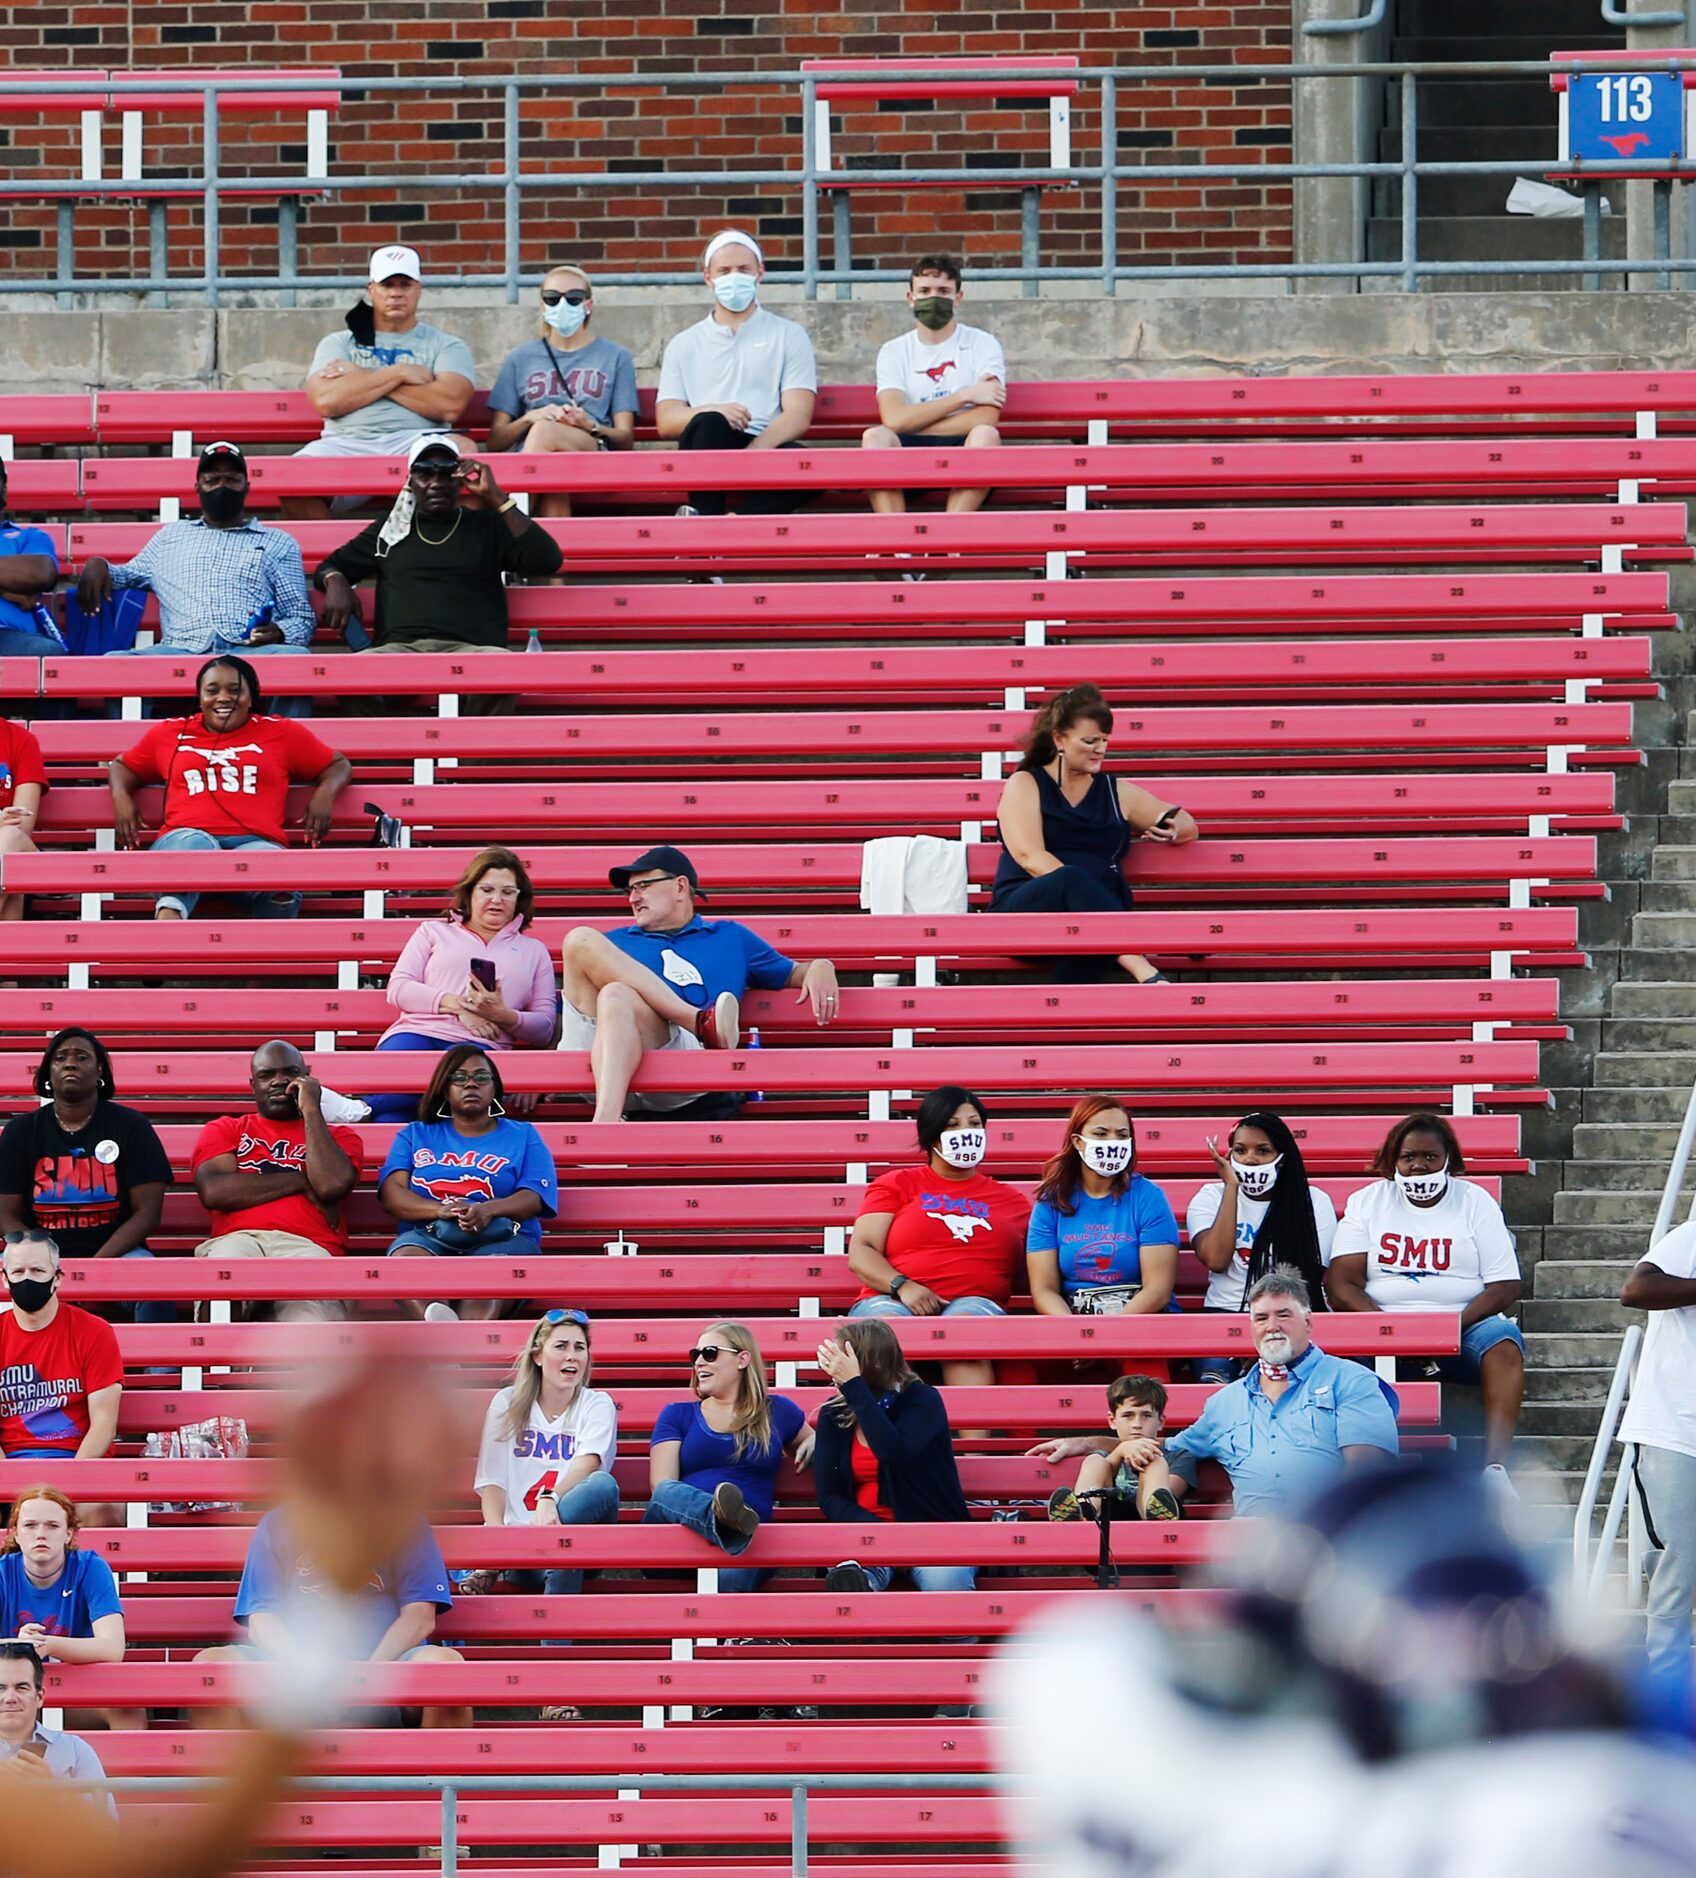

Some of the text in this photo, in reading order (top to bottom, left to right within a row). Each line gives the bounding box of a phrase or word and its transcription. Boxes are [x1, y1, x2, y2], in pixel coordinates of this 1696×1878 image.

[1596, 76, 1652, 122] 113
[526, 368, 608, 402] SMU
[892, 594, 905, 603] 18
[451, 665, 464, 675] 15
[183, 765, 259, 797] RISE
[1537, 786, 1551, 796] 22
[967, 792, 980, 802] 18
[1374, 851, 1387, 861] 21
[1519, 850, 1533, 860] 22
[93, 864, 106, 873] 12
[377, 861, 389, 871] 14
[1209, 924, 1224, 934] 20
[1046, 997, 1059, 1007] 19
[1191, 996, 1206, 1006] 20
[1335, 994, 1347, 1003] 21
[1478, 992, 1493, 1002] 22
[903, 999, 915, 1009] 18
[1023, 1059, 1037, 1068] 19
[1459, 1054, 1474, 1064] 22
[732, 1061, 745, 1071] 17
[877, 1060, 890, 1070] 18
[565, 1135, 577, 1145] 15
[710, 1134, 723, 1144] 16
[855, 1133, 869, 1143] 17
[949, 1132, 984, 1151] SMU
[955, 1152, 977, 1162] #96
[1094, 1146, 1128, 1160] SMU
[413, 1147, 510, 1175] SMU
[34, 1155, 118, 1199] SMU
[1403, 1181, 1440, 1194] SMU
[686, 1199, 699, 1208] 16
[832, 1197, 846, 1206] 17
[920, 1191, 992, 1219] SMU
[1378, 1232, 1453, 1271] SMU
[72, 1271, 85, 1281] 12
[218, 1270, 231, 1280] 13
[366, 1270, 379, 1279] 14
[513, 1269, 526, 1279] 15
[660, 1268, 673, 1278] 16
[807, 1267, 822, 1277] 17
[932, 1330, 945, 1339] 18
[1081, 1328, 1095, 1338] 19
[1379, 1325, 1393, 1336] 21
[635, 1333, 647, 1342] 16
[784, 1331, 798, 1341] 17
[192, 1336, 205, 1347] 13
[0, 1395, 68, 1418] CHAMPION
[1059, 1398, 1073, 1408] 19
[513, 1429, 576, 1461] SMU
[137, 1471, 149, 1482] 12
[559, 1538, 572, 1548] 15
[1013, 1535, 1025, 1545] 18
[1163, 1534, 1178, 1543] 19
[107, 1541, 120, 1551] 12
[659, 1675, 672, 1685] 16
[479, 1743, 491, 1753] 15
[764, 1812, 777, 1822] 16
[919, 1811, 933, 1821] 17
